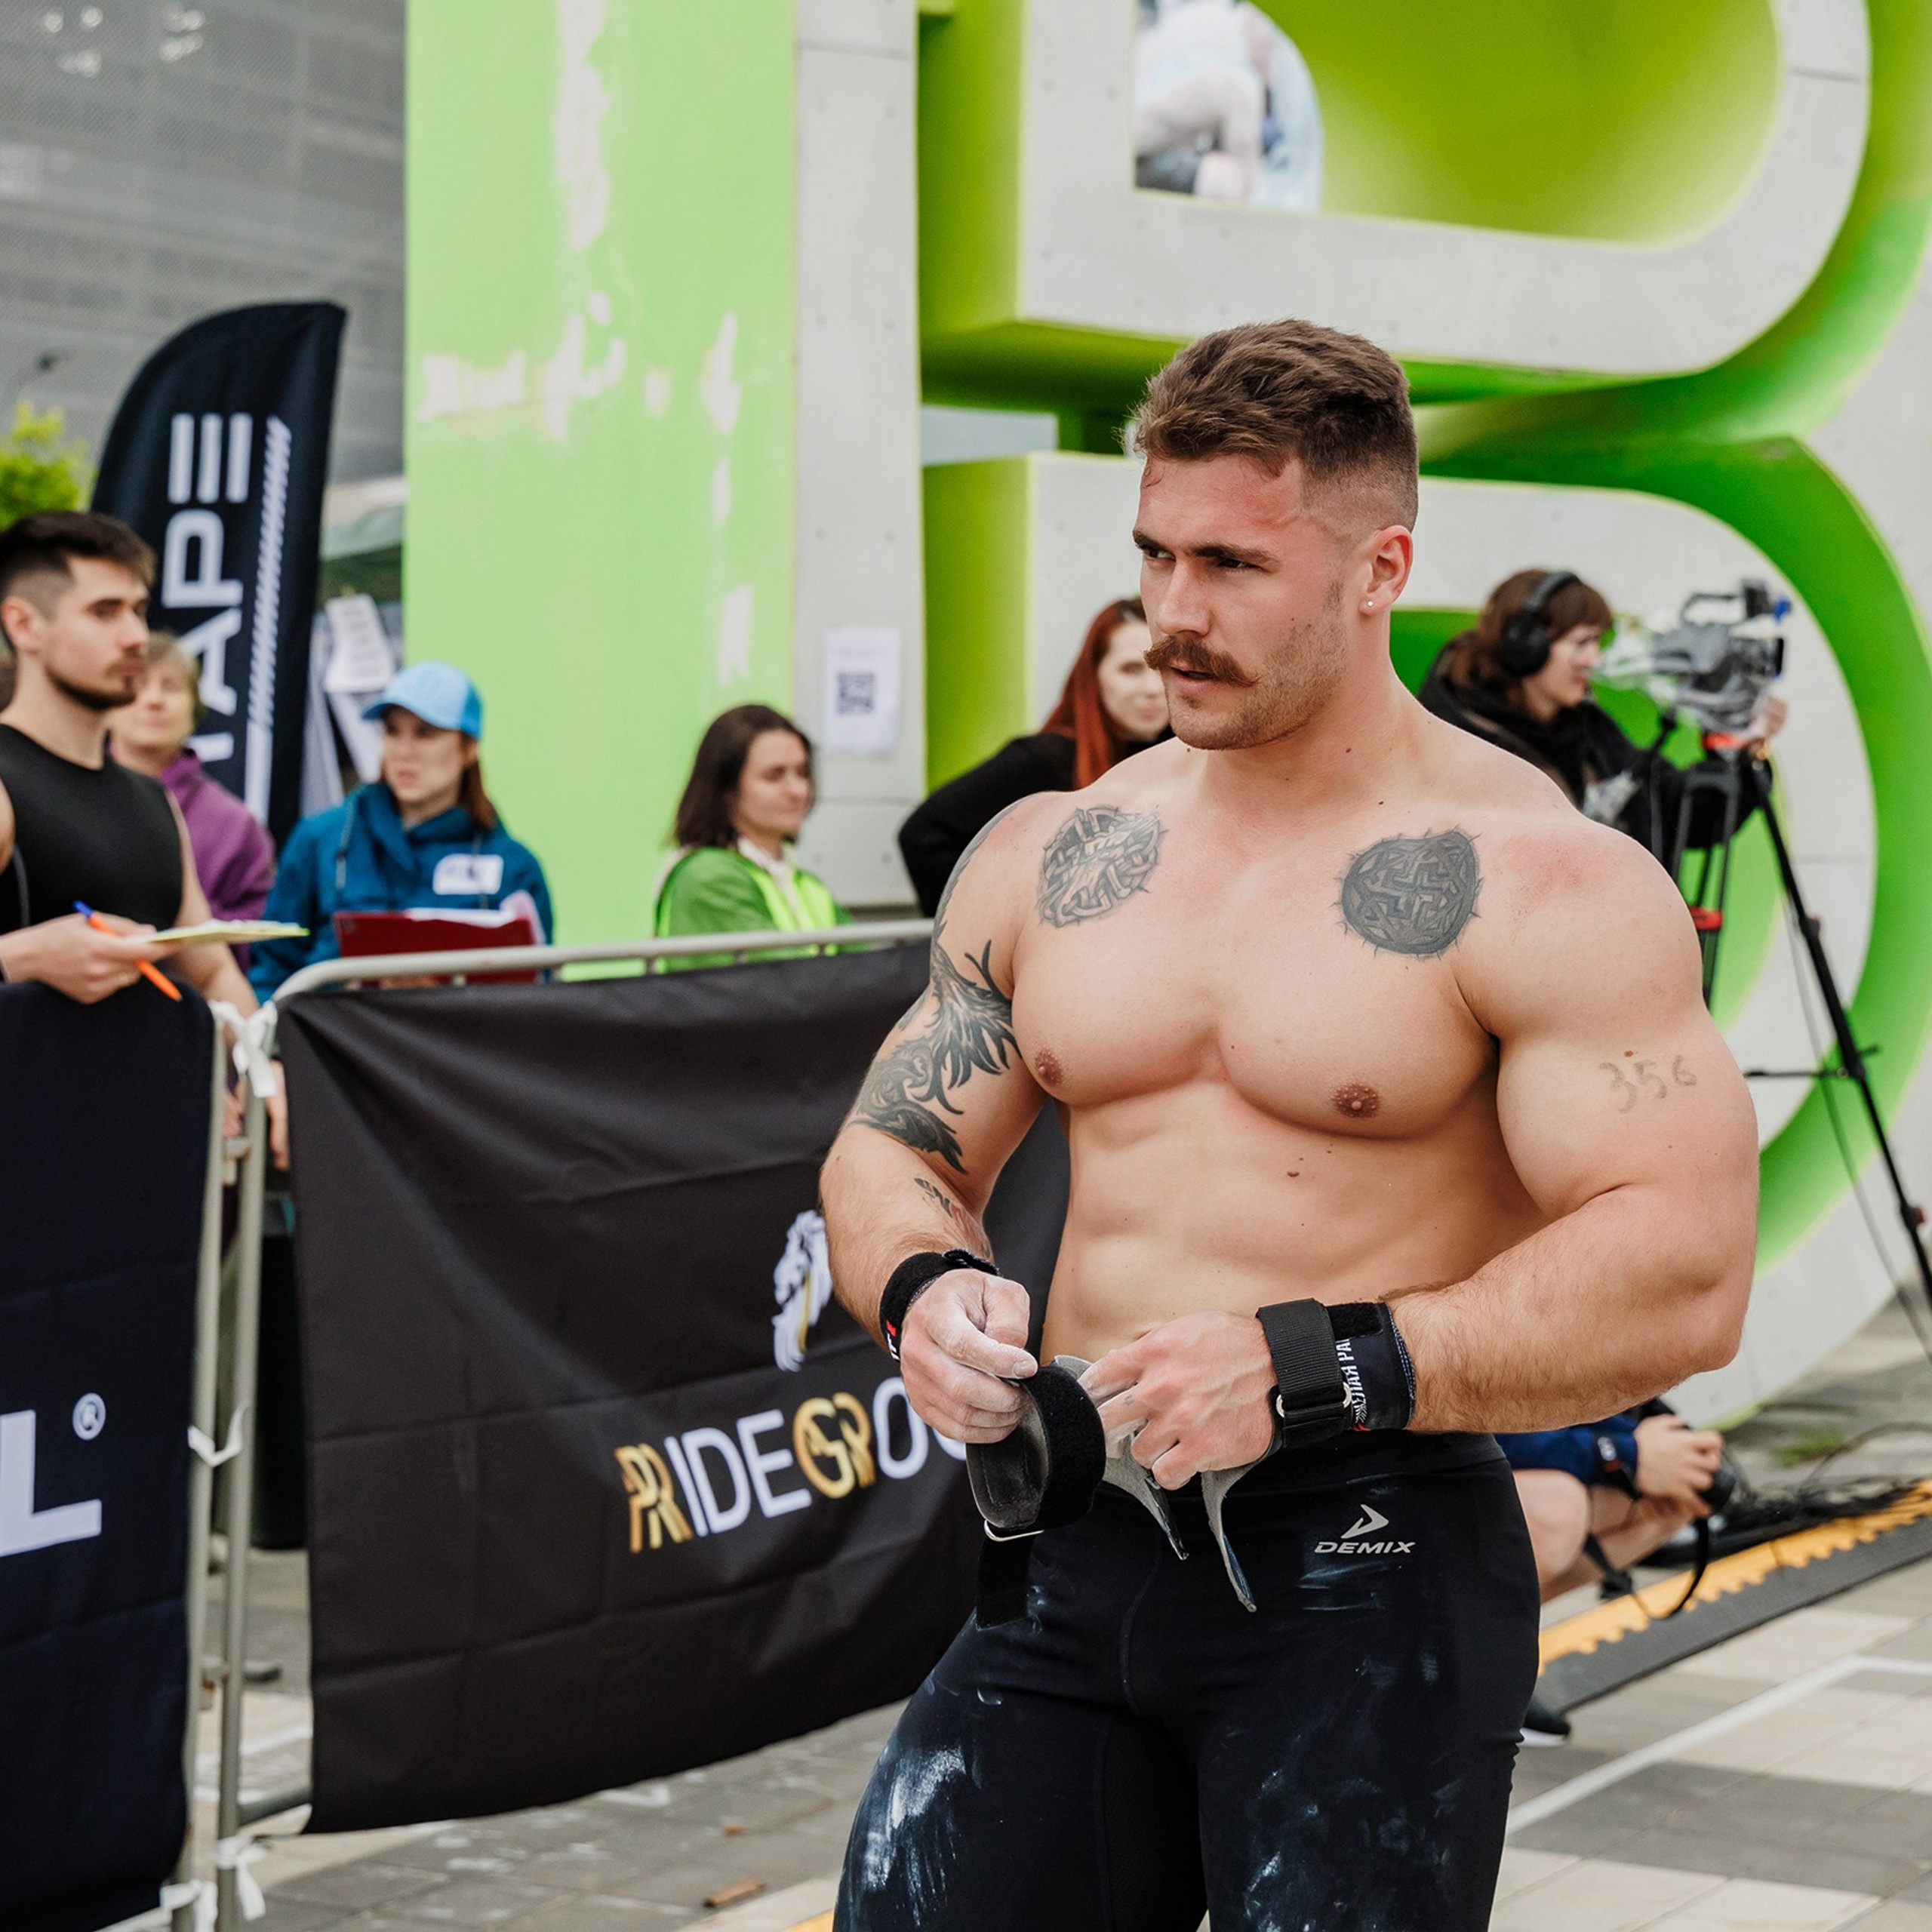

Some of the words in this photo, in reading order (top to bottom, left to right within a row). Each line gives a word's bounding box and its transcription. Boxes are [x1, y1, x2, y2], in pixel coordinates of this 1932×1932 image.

[162, 413, 254, 761] APE
[1598, 1054, 1697, 1115] 356
[1314, 1541, 1417, 1554] DEMIX
